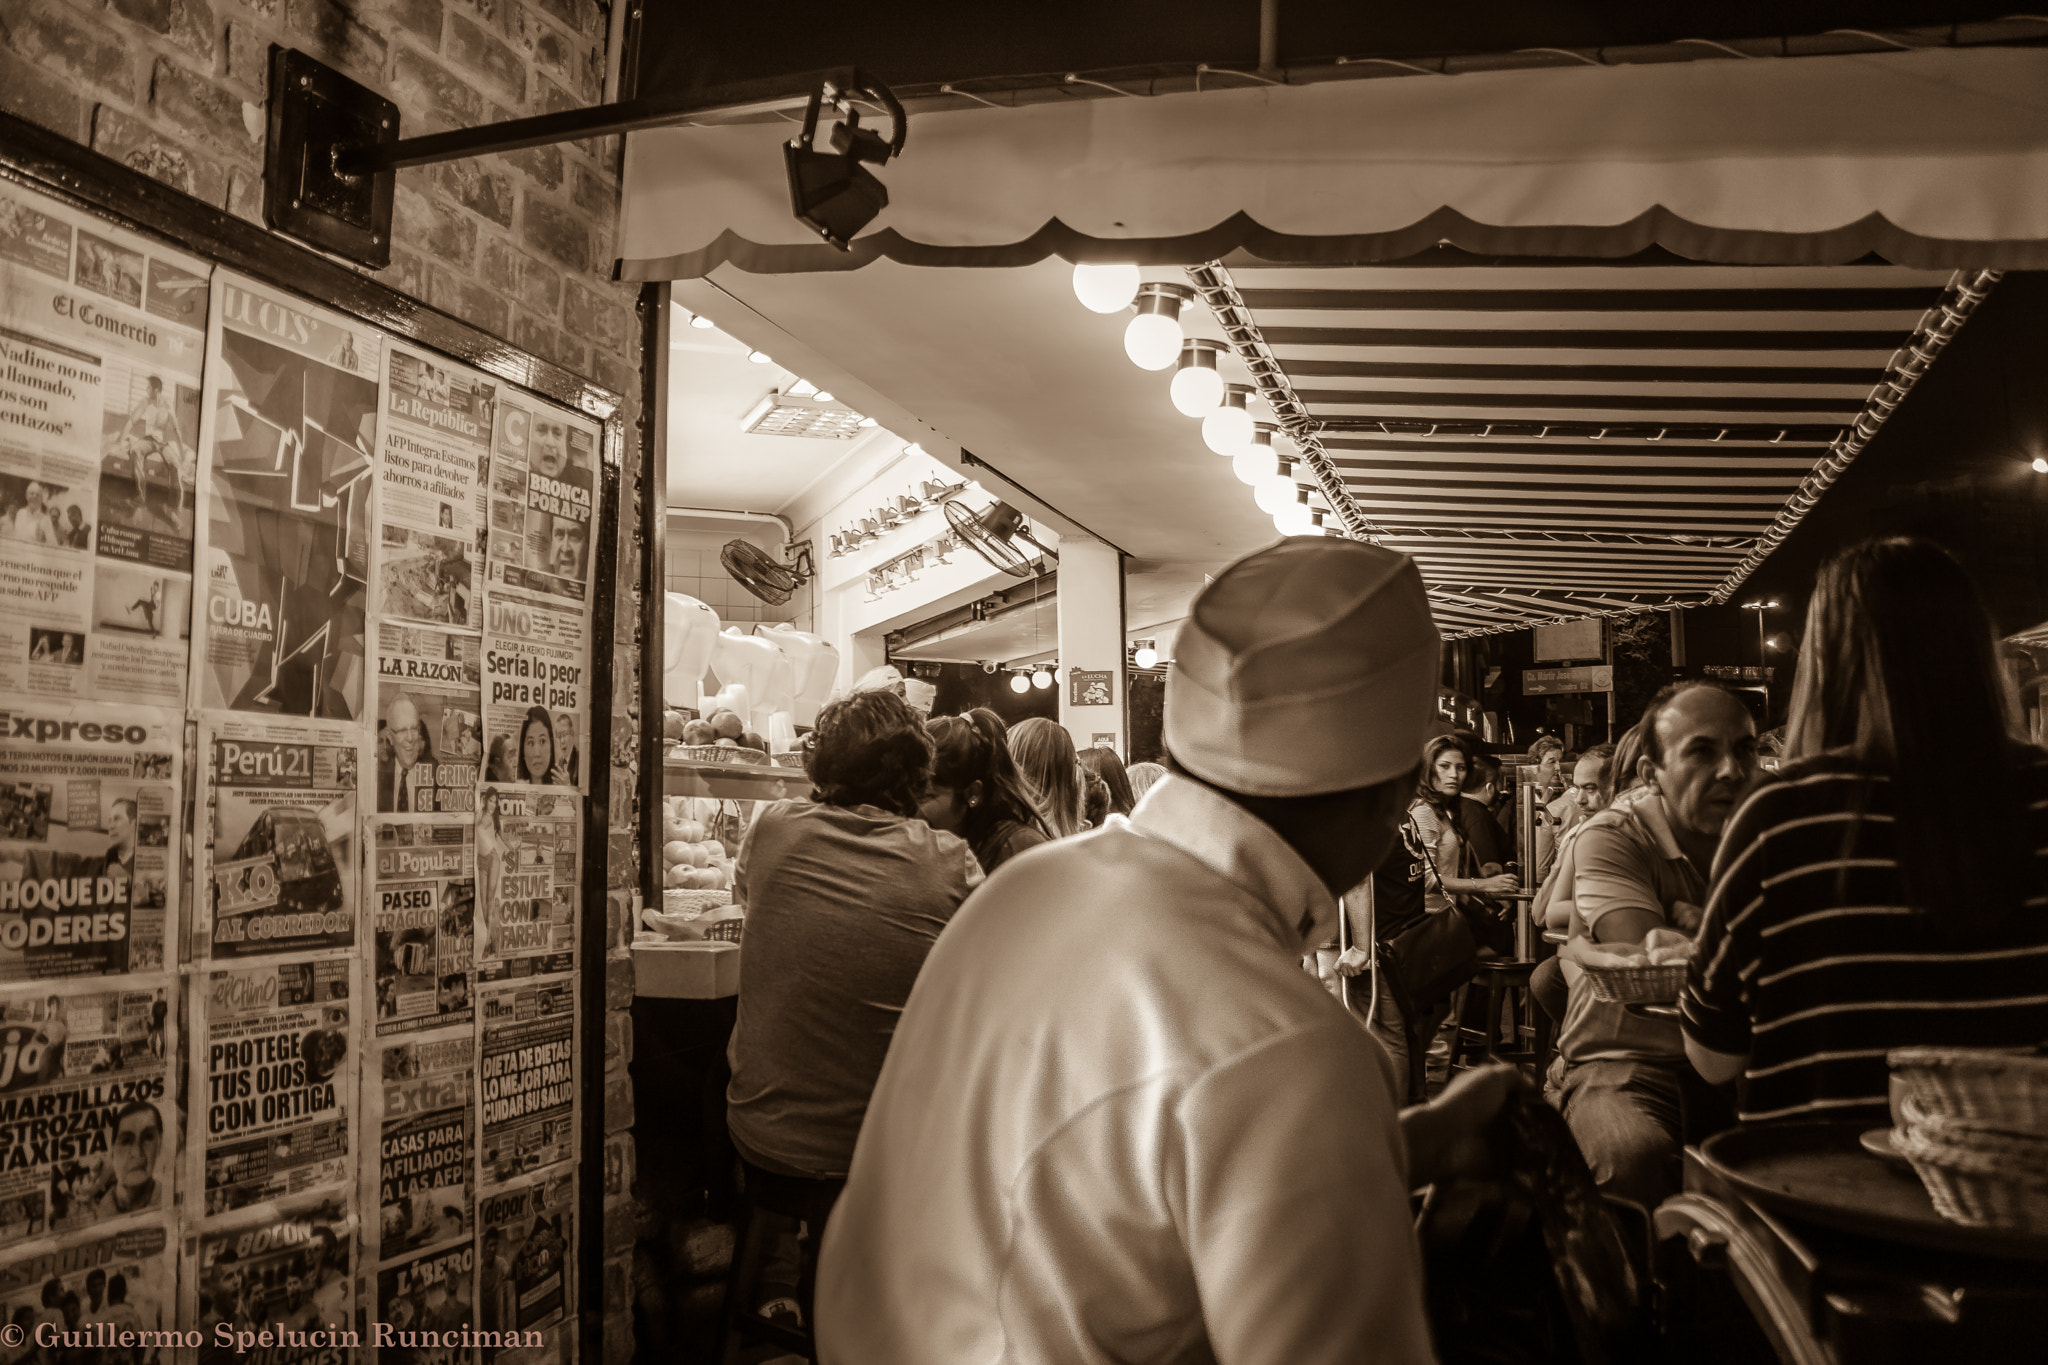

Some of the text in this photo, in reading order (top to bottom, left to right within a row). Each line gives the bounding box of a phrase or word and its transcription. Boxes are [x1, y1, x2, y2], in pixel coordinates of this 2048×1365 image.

[52, 293, 75, 319] El
[79, 301, 157, 348] Comercio
[7, 364, 76, 401] llamado,
[58, 364, 77, 379] no
[81, 370, 101, 386] me
[19, 394, 48, 412] son
[389, 392, 478, 437] La República
[384, 450, 469, 485] listos para devolver
[385, 434, 408, 448] AFP
[441, 450, 476, 470] Estamos
[383, 468, 465, 501] ahorros a afiliados
[530, 472, 590, 507] BRONCA
[529, 490, 591, 523] POR AFP
[35, 579, 78, 592] respalde
[53, 569, 71, 580] que
[73, 569, 82, 581] el
[37, 590, 59, 602] AFP
[209, 595, 272, 631] CUBA
[243, 630, 273, 642] CUADRO
[489, 606, 531, 636] UNO
[495, 640, 519, 652] ELEGIR
[520, 644, 526, 652] A
[527, 645, 545, 656] KEIKO
[378, 657, 404, 677] LA
[487, 650, 581, 685] Sería lo peor
[492, 681, 577, 710] para el país
[0, 713, 147, 745] Expreso
[9, 751, 60, 762] TERREMOTOS
[62, 753, 72, 762] EN
[98, 754, 123, 765] DEJAN
[123, 756, 133, 765] AL
[31, 765, 68, 775] MUERTOS
[97, 767, 130, 777] HERIDOS
[220, 743, 284, 776] Perú
[286, 749, 311, 776] 21
[418, 789, 433, 811] SE
[380, 850, 460, 876] el Popular
[0, 876, 128, 912] HOQUE DE
[216, 864, 280, 910] K.O.
[382, 890, 431, 911] PASEO
[501, 875, 550, 899] ESTUVE
[214, 912, 350, 943] AL CORREDOR
[501, 900, 529, 924] CON
[0, 912, 126, 949] ODERES
[209, 1033, 300, 1073] PROTEGE
[483, 1052, 517, 1079] DIETA
[519, 1047, 534, 1071] DE
[534, 1039, 571, 1067] DIETAS
[209, 1061, 305, 1103] TUS OJOS
[483, 1060, 571, 1102] LO MEJOR PARA
[0, 1077, 164, 1122] MARTILLAZOS
[209, 1083, 336, 1134] CON ORTIGA
[384, 1081, 456, 1118] Extra
[482, 1081, 573, 1125] CUIDAR SU SALUD
[0, 1106, 118, 1147] STROZAN
[382, 1124, 463, 1159] CASAS PARA
[0, 1130, 108, 1172] TAXISTA
[382, 1145, 463, 1182] AFILIADOS
[382, 1166, 463, 1203] A LAS AFP
[485, 1194, 526, 1225] depor
[397, 1248, 473, 1296] LÍBERO
